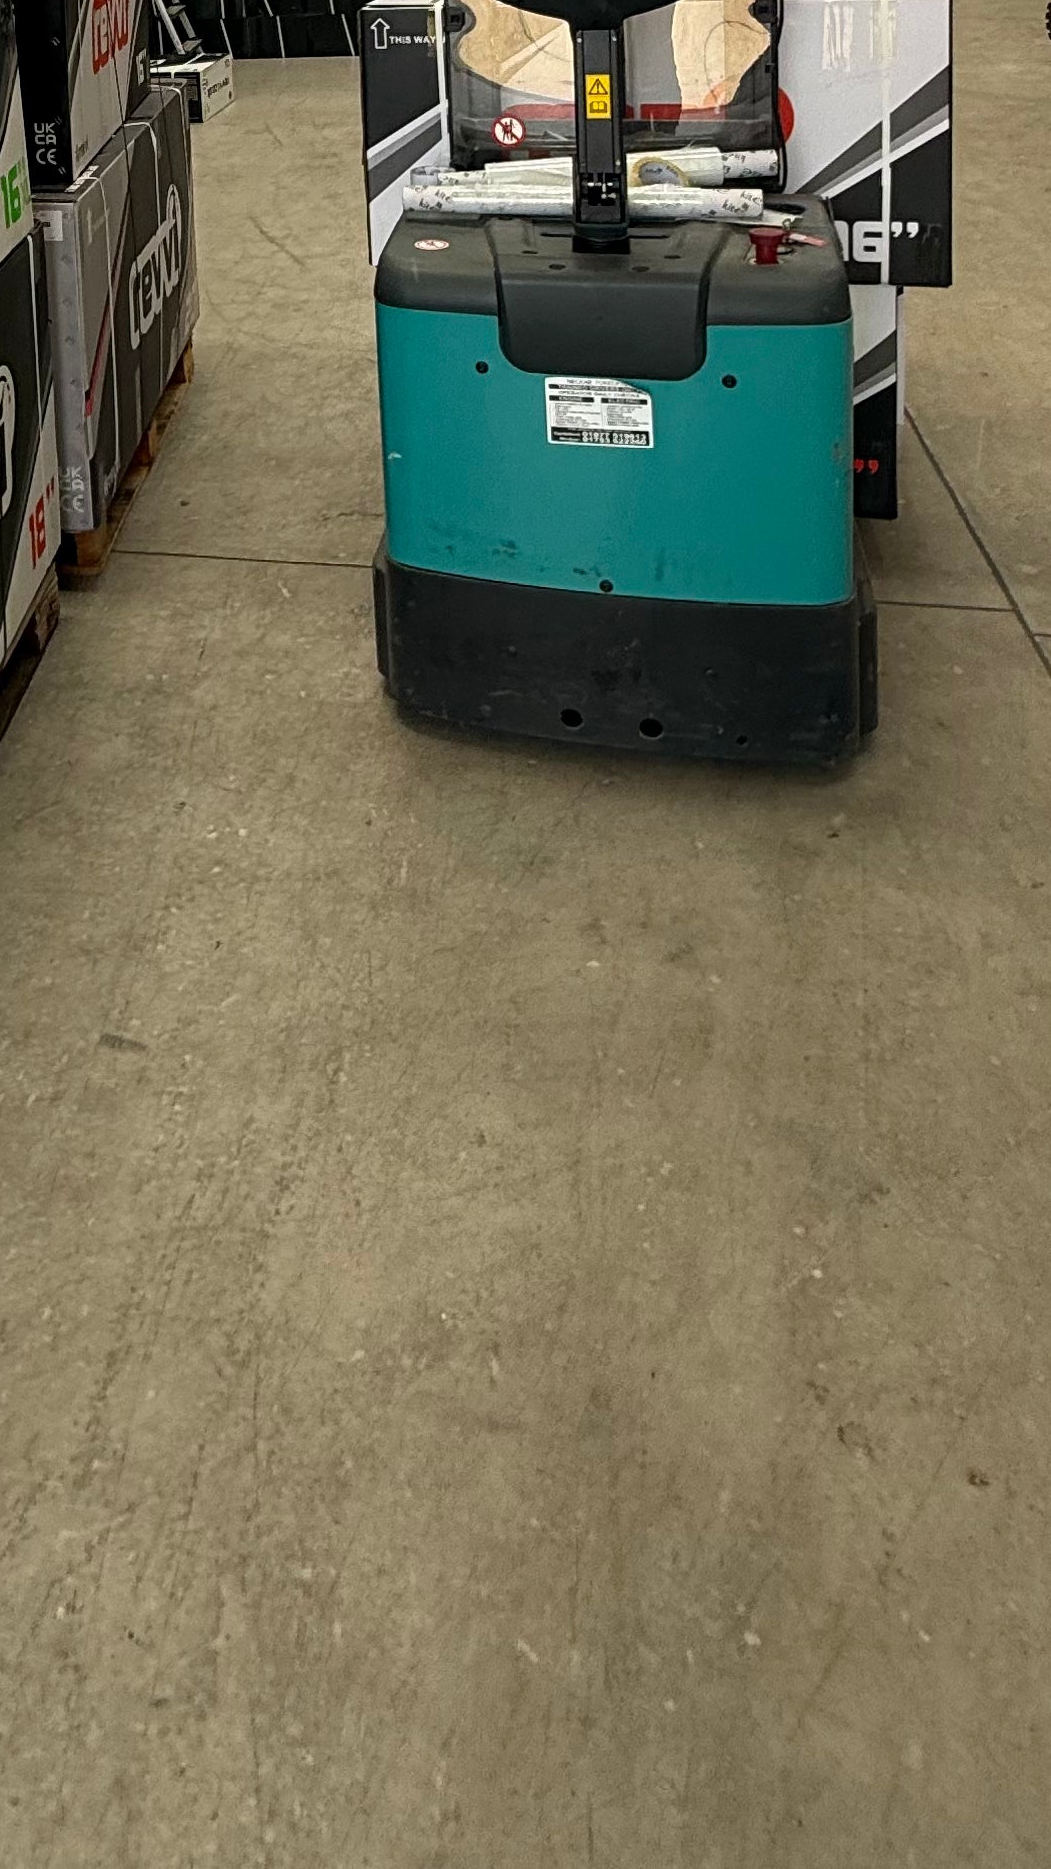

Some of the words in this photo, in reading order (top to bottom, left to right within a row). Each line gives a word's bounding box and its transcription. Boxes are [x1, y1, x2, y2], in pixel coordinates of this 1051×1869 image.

[389, 35, 412, 45] THIS
[414, 35, 435, 45] WAY
[34, 122, 55, 134] UK
[129, 184, 182, 350] revvi
